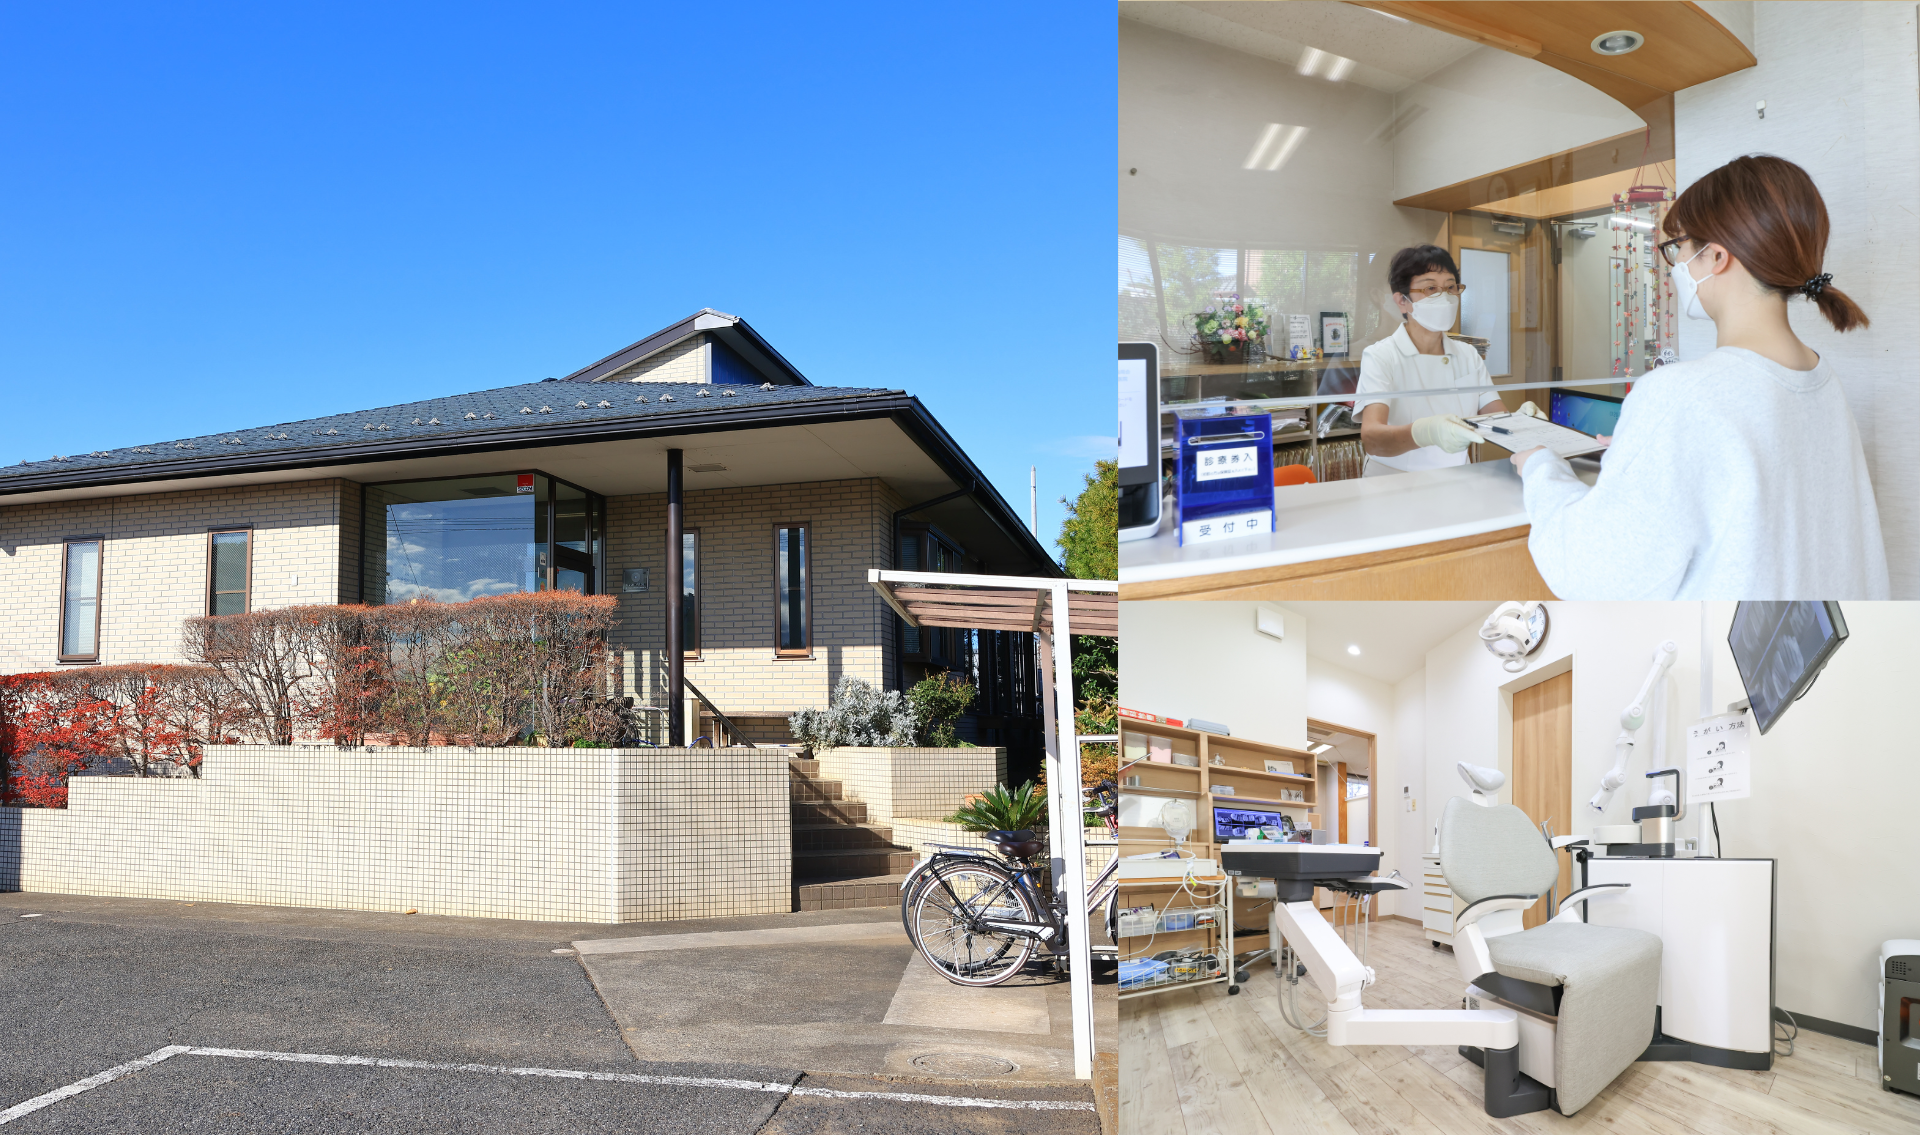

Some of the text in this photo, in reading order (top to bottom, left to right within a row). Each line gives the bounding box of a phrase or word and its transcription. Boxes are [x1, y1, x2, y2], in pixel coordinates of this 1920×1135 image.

[1204, 453, 1253, 467] 診療券入
[1199, 518, 1258, 537] 受付中
